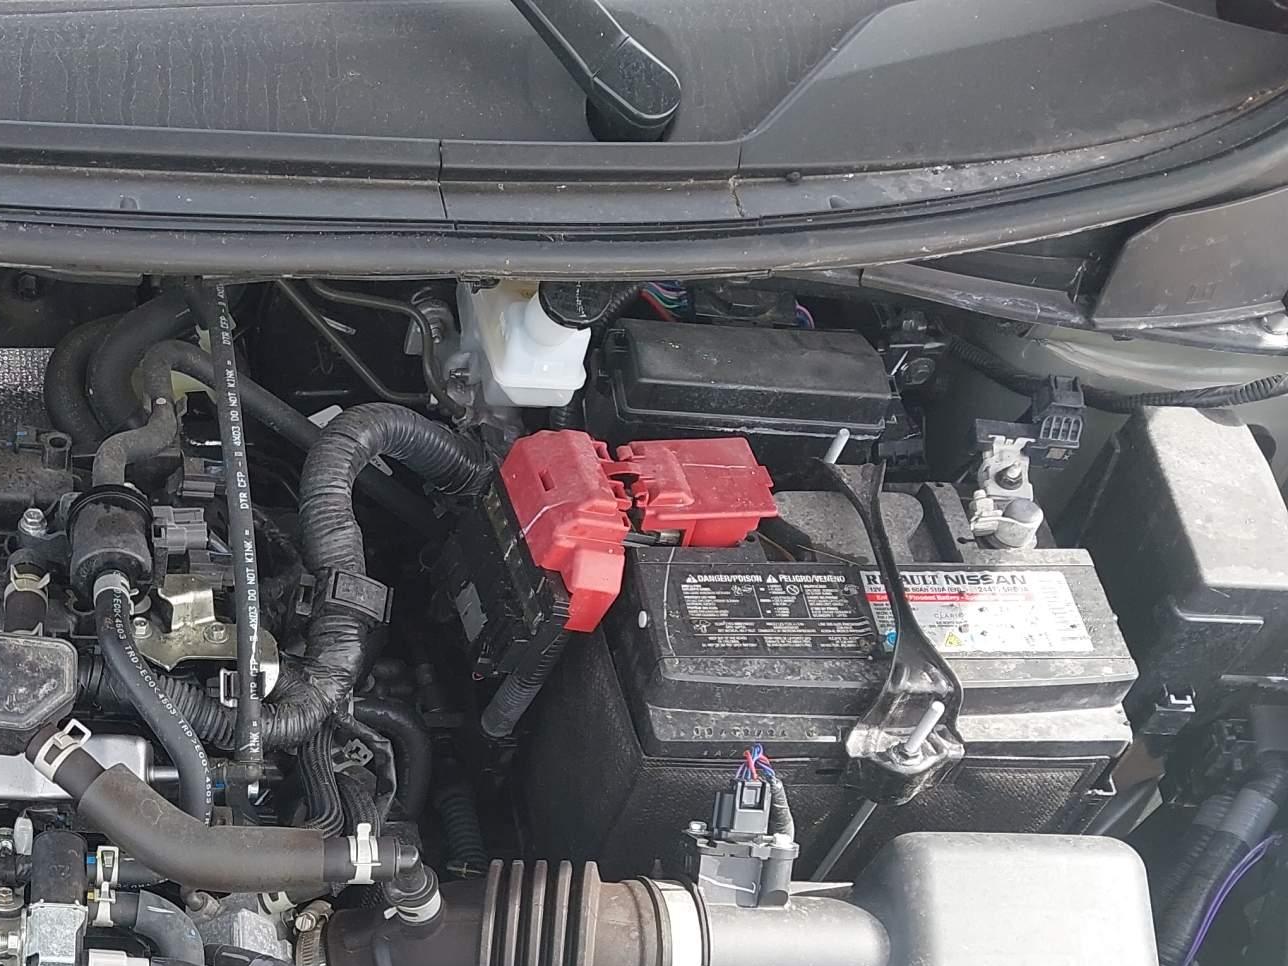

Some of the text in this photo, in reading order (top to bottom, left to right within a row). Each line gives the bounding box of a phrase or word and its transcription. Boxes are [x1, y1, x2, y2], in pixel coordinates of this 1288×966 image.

[236, 472, 247, 488] CFP
[238, 492, 250, 510] DTR
[244, 540, 254, 564] KINK
[698, 574, 762, 583] DANGER/POISON
[778, 574, 846, 583] PELIGRO/VENENO
[866, 574, 1026, 585] RAULT NISSAN
